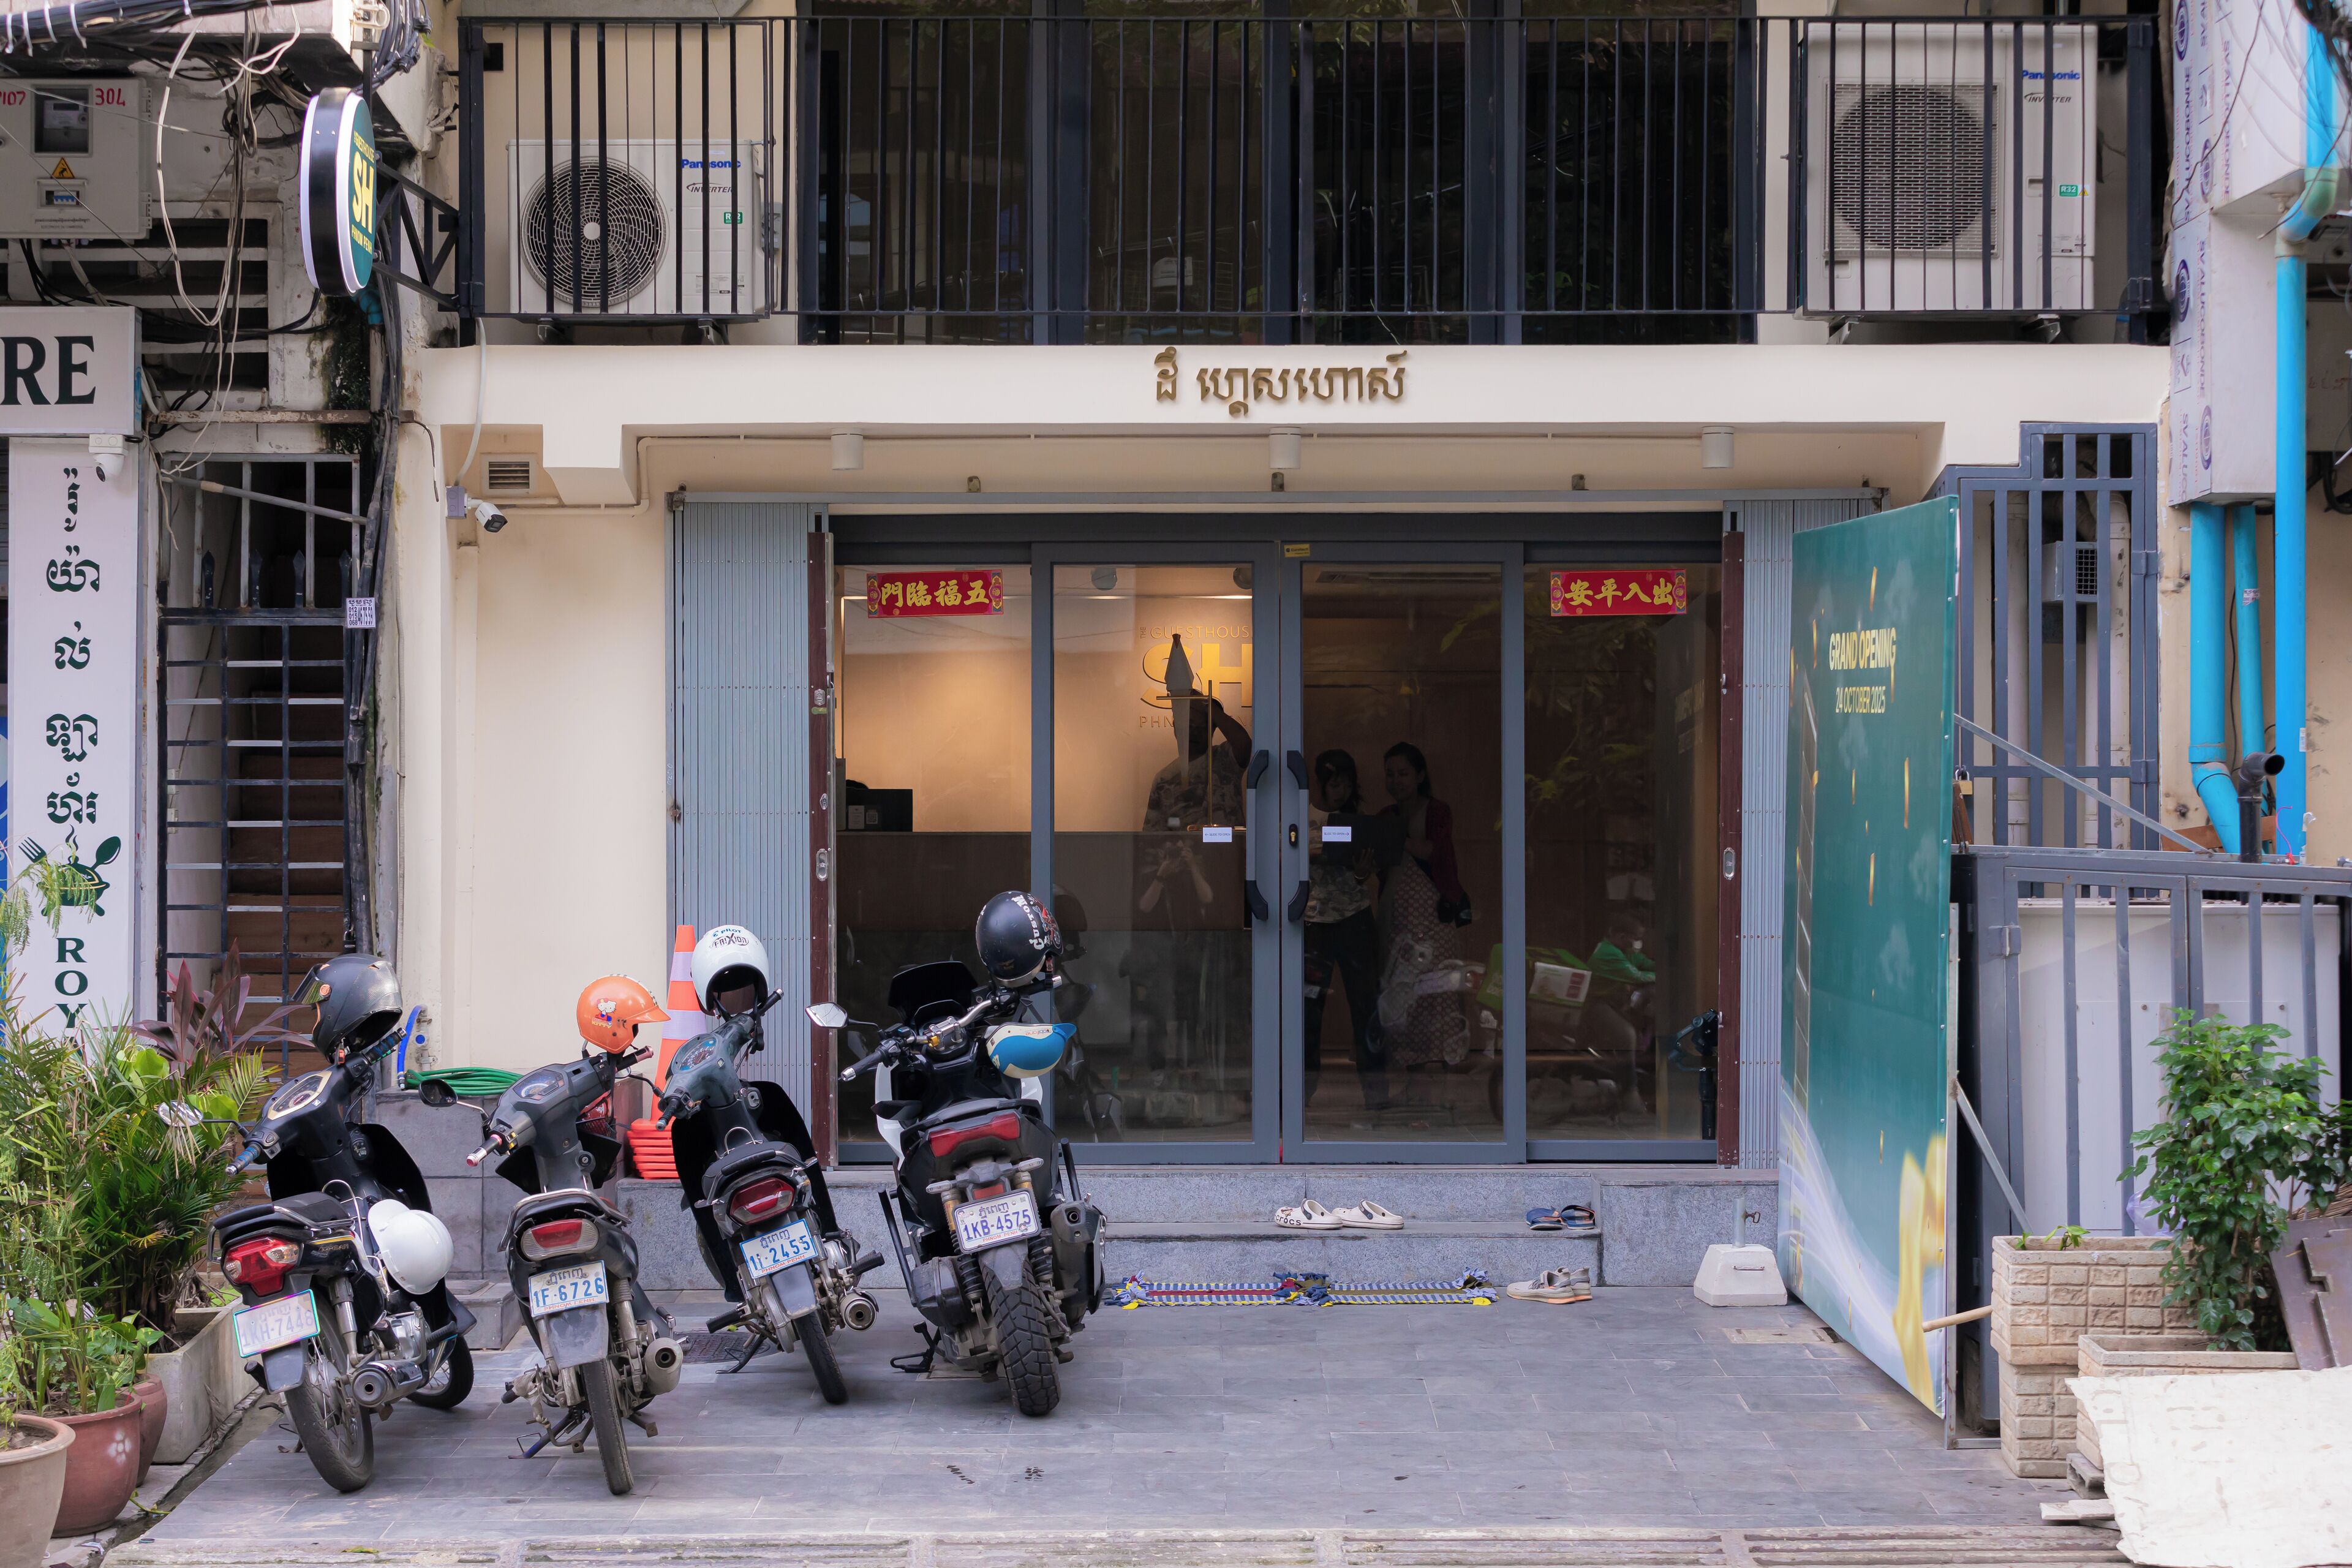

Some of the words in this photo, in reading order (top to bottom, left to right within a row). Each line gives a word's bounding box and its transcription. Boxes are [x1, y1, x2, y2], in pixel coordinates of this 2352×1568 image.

[682, 159, 741, 168] Pansonc
[353, 151, 374, 234] SH
[0, 336, 96, 405] RE
[1150, 626, 1253, 639] GUESTHOUS
[1829, 631, 1858, 670] GRAND
[1859, 627, 1897, 669] OPENING
[1835, 687, 1843, 713] 24
[1844, 686, 1870, 713] OCTOBER
[1870, 686, 1886, 713] 2025
[963, 1208, 1031, 1240] 1KB-4575
[1276, 1214, 1302, 1226] crocs
[982, 1234, 1001, 1243] PHNOM
[761, 1262, 786, 1273] PHNOM
[787, 1254, 805, 1264] PENH
